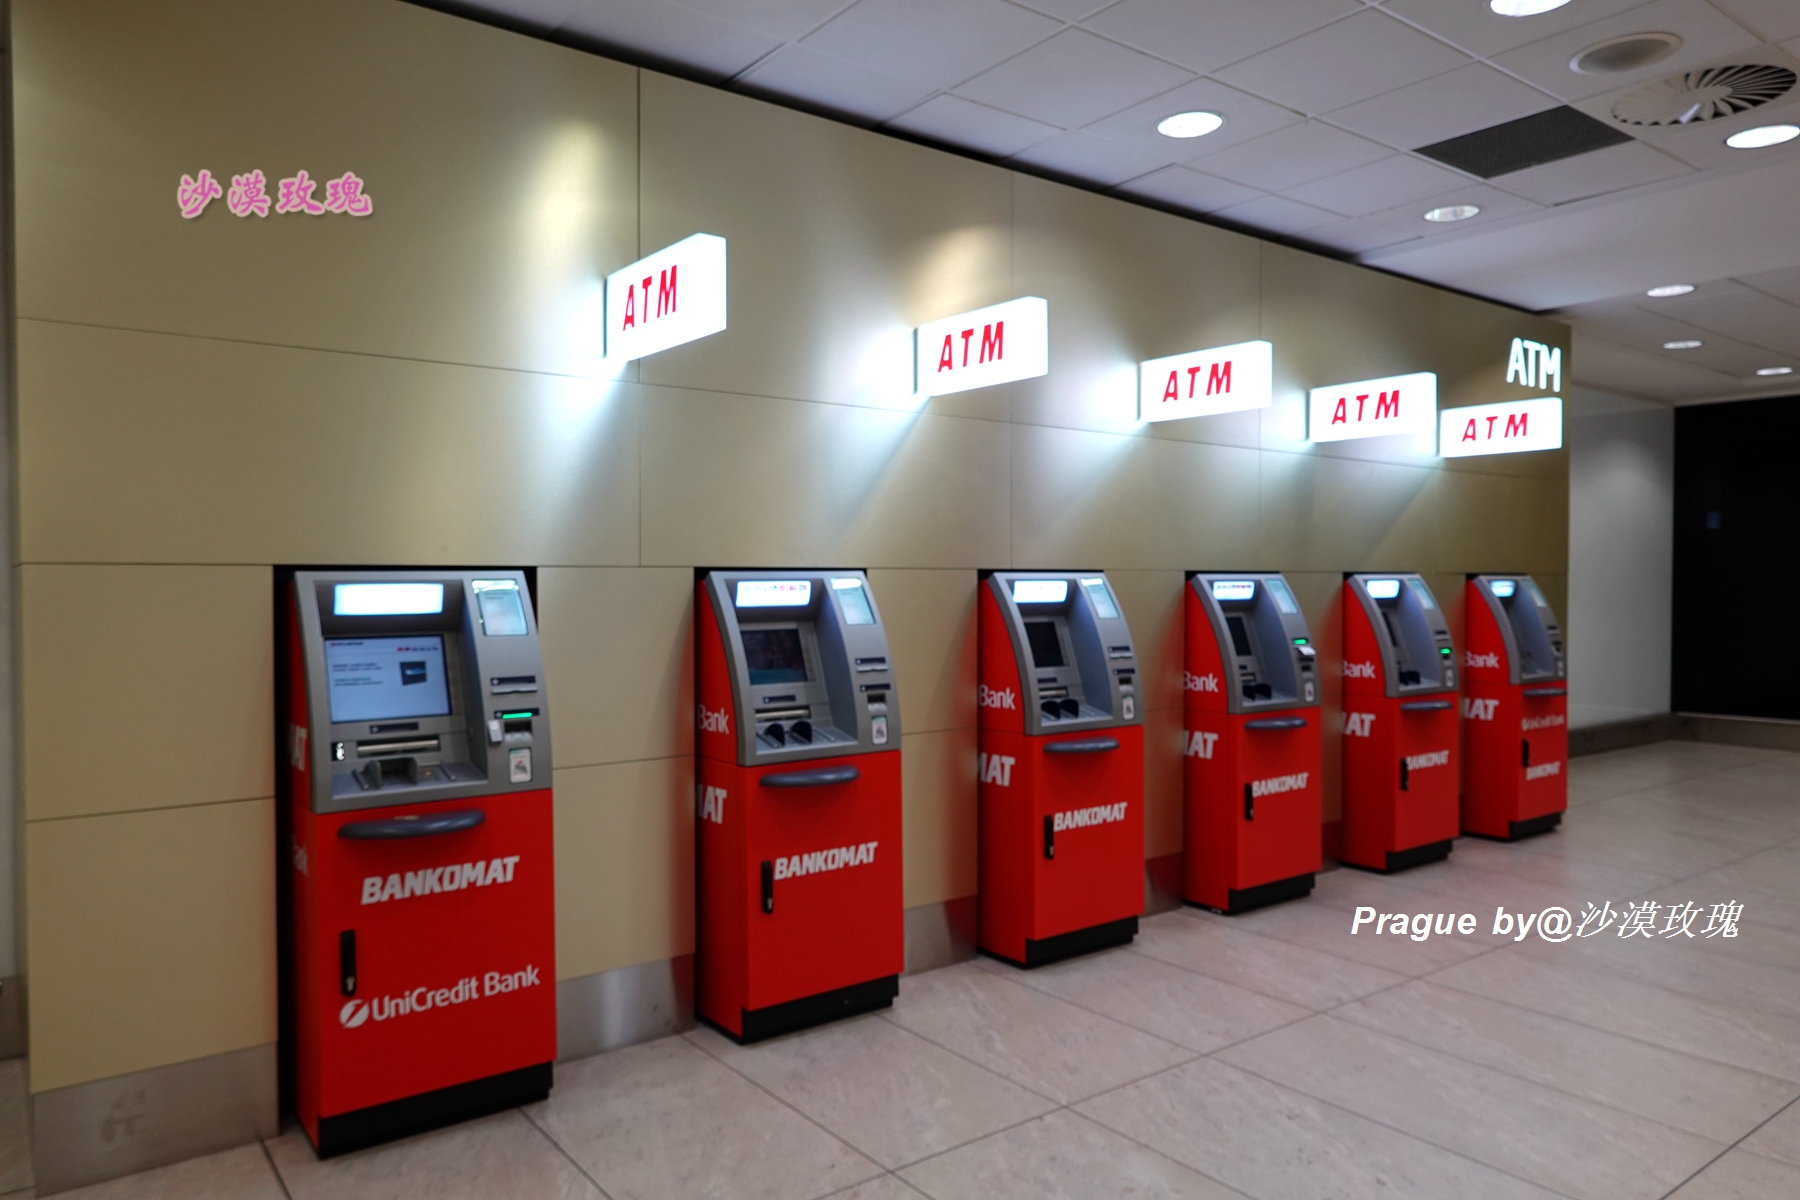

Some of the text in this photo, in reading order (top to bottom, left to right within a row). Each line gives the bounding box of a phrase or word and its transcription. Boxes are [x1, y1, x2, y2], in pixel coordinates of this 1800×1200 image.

[623, 264, 677, 331] ATM
[938, 321, 1004, 373] ATM
[1506, 337, 1562, 393] ATM
[1163, 361, 1232, 403] ATM
[1331, 390, 1400, 425] ATM
[1462, 413, 1528, 442] ATM
[979, 684, 1016, 710] Bank
[698, 704, 730, 734] Bank
[1252, 772, 1309, 798] BANKOMAT
[1053, 802, 1128, 832] BANKOMAT
[774, 841, 878, 880] BANKOMAT
[361, 856, 520, 905] BANKOMAT
[371, 964, 540, 1021] UniCredit Bank
